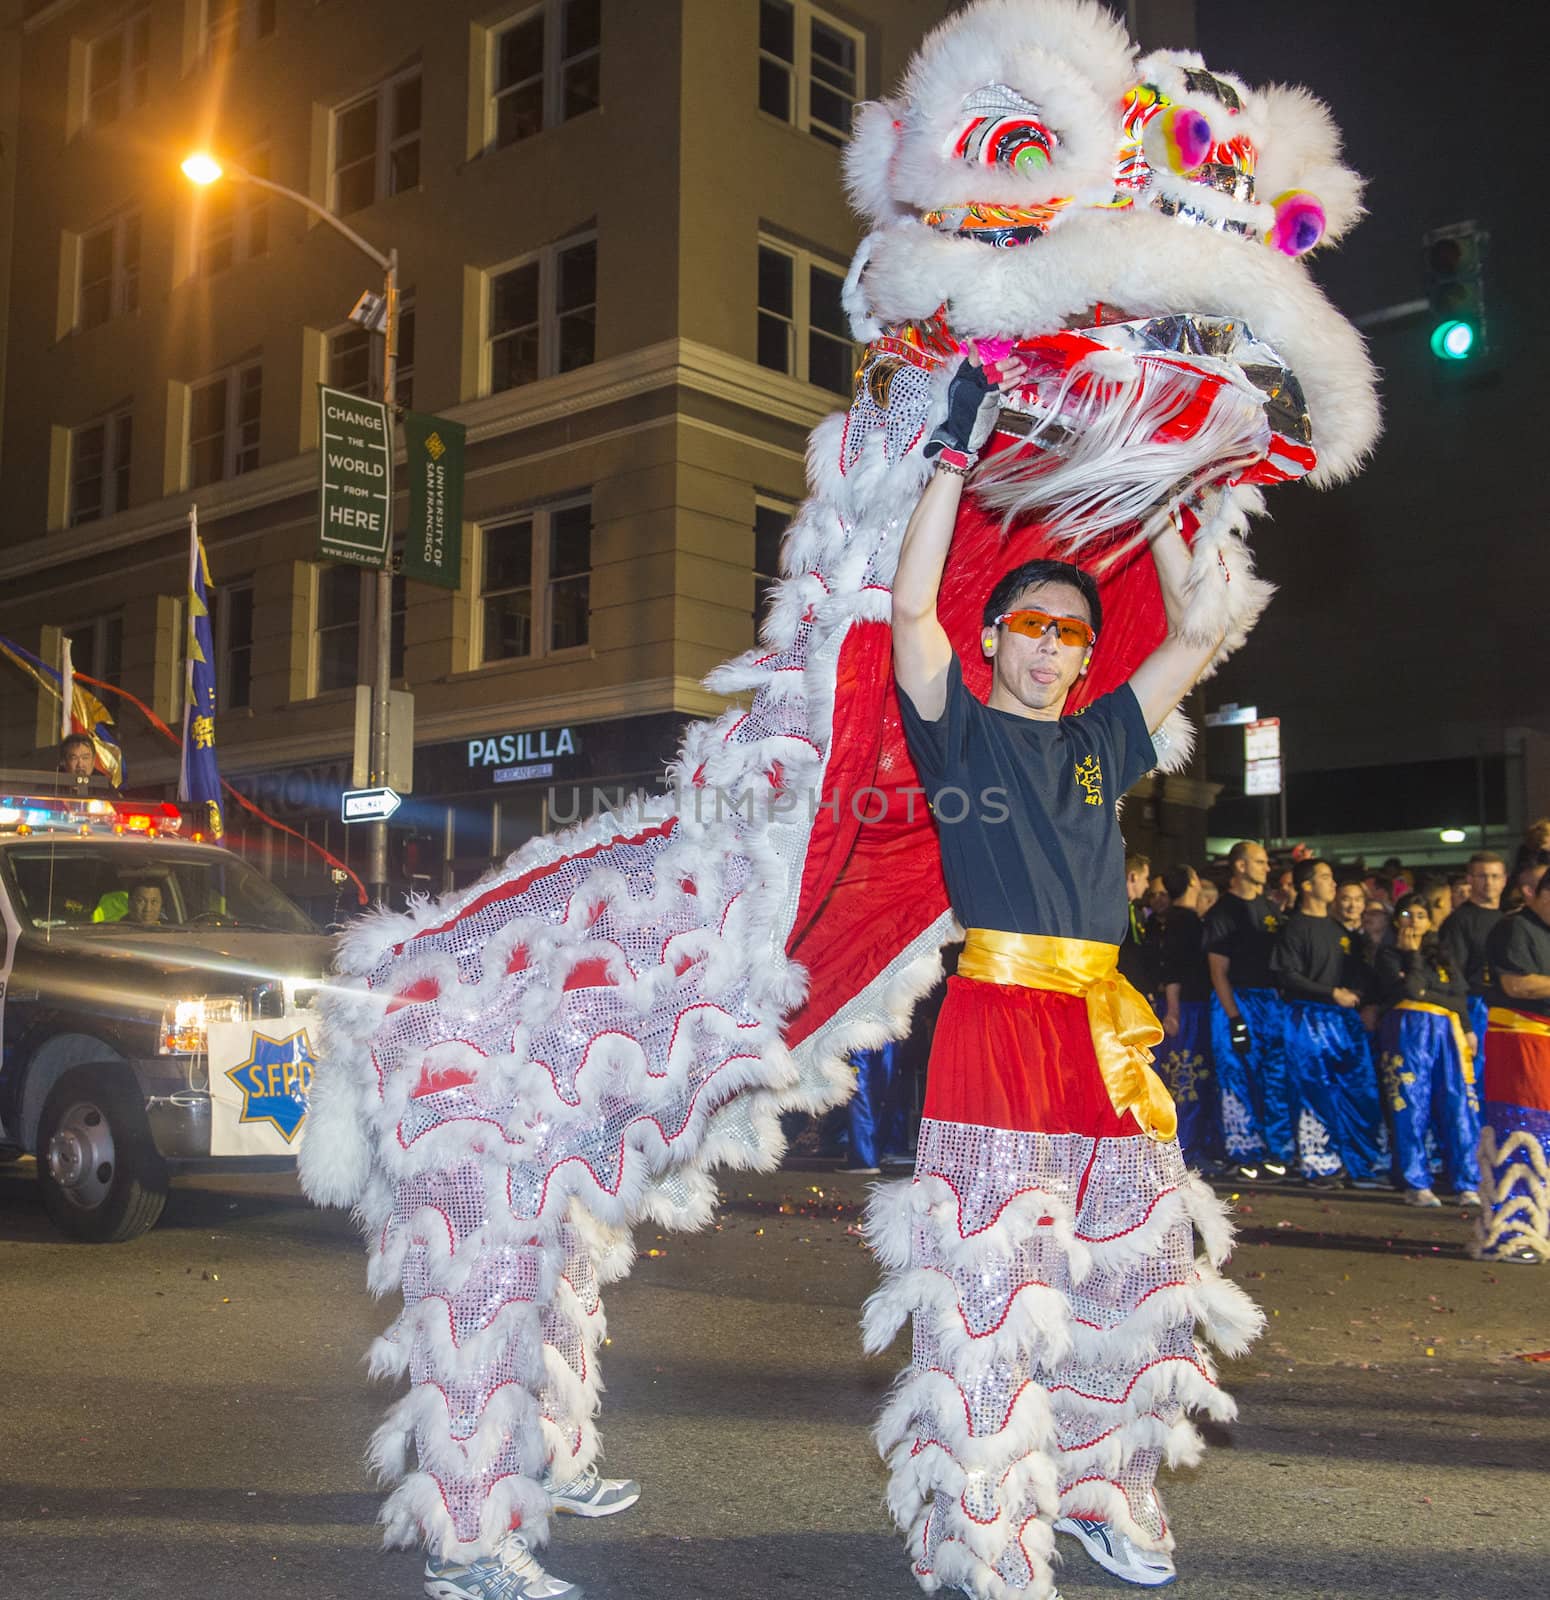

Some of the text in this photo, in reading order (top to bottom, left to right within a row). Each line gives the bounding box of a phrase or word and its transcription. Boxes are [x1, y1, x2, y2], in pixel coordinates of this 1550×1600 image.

[327, 406, 383, 431] CHANGE
[347, 436, 365, 448] THE
[328, 453, 385, 477] WORLD
[343, 485, 369, 498] FROM
[330, 505, 380, 531] HERE
[424, 462, 435, 562] SAN FRANCISCO
[434, 465, 444, 568] UNIVERSITY OF
[322, 547, 382, 564] www.usfca.edu
[468, 728, 575, 767] PASILLA
